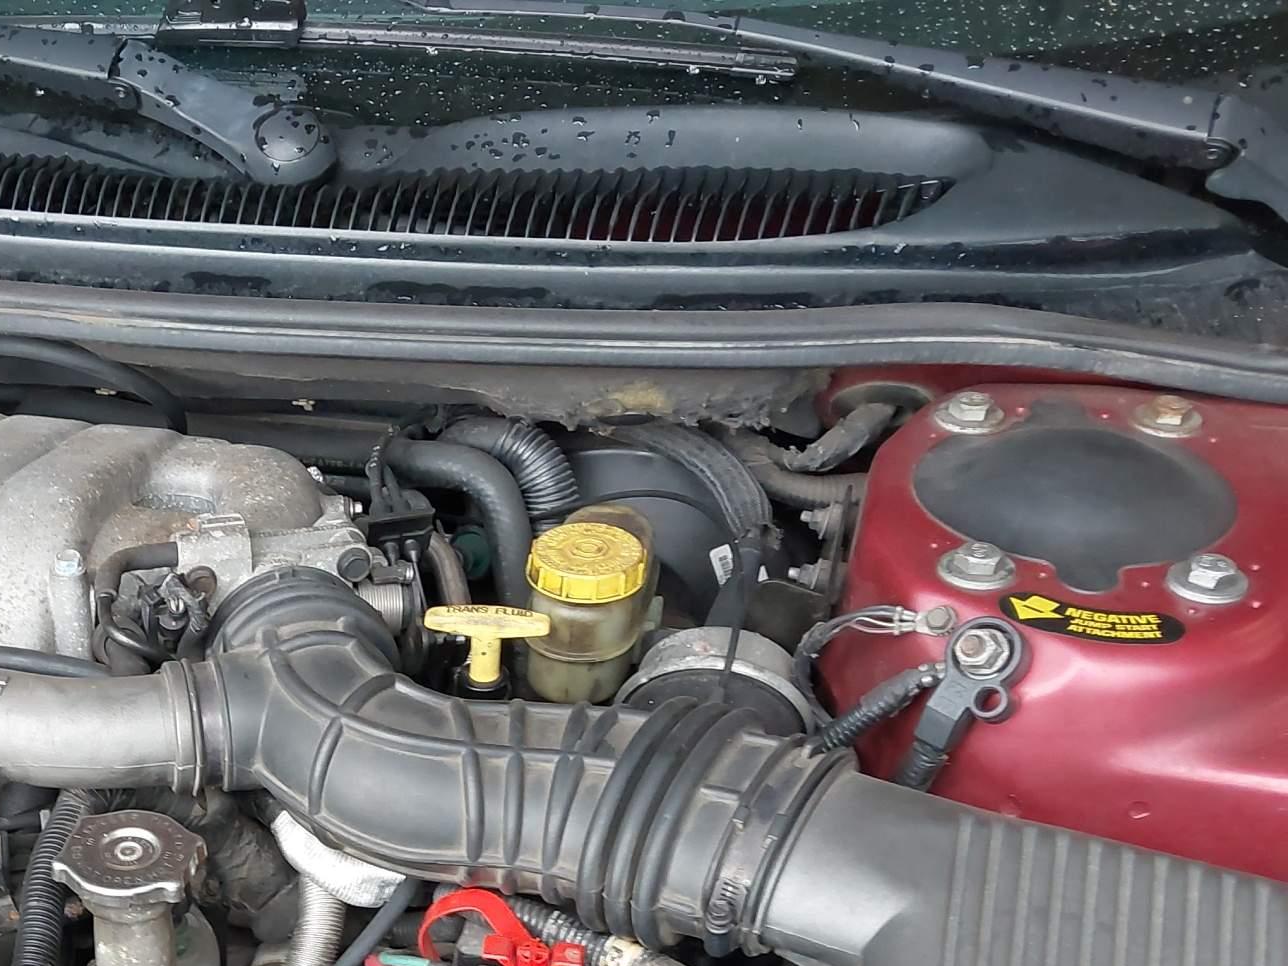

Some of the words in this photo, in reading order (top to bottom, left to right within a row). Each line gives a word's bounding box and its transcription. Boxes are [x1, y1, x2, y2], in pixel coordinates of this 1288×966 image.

[445, 605, 489, 614] TRANS
[495, 606, 534, 618] FLUID
[1064, 607, 1162, 624] NEGATIVE
[1069, 618, 1113, 629] JUMP
[1066, 624, 1163, 639] ATTACHMENT
